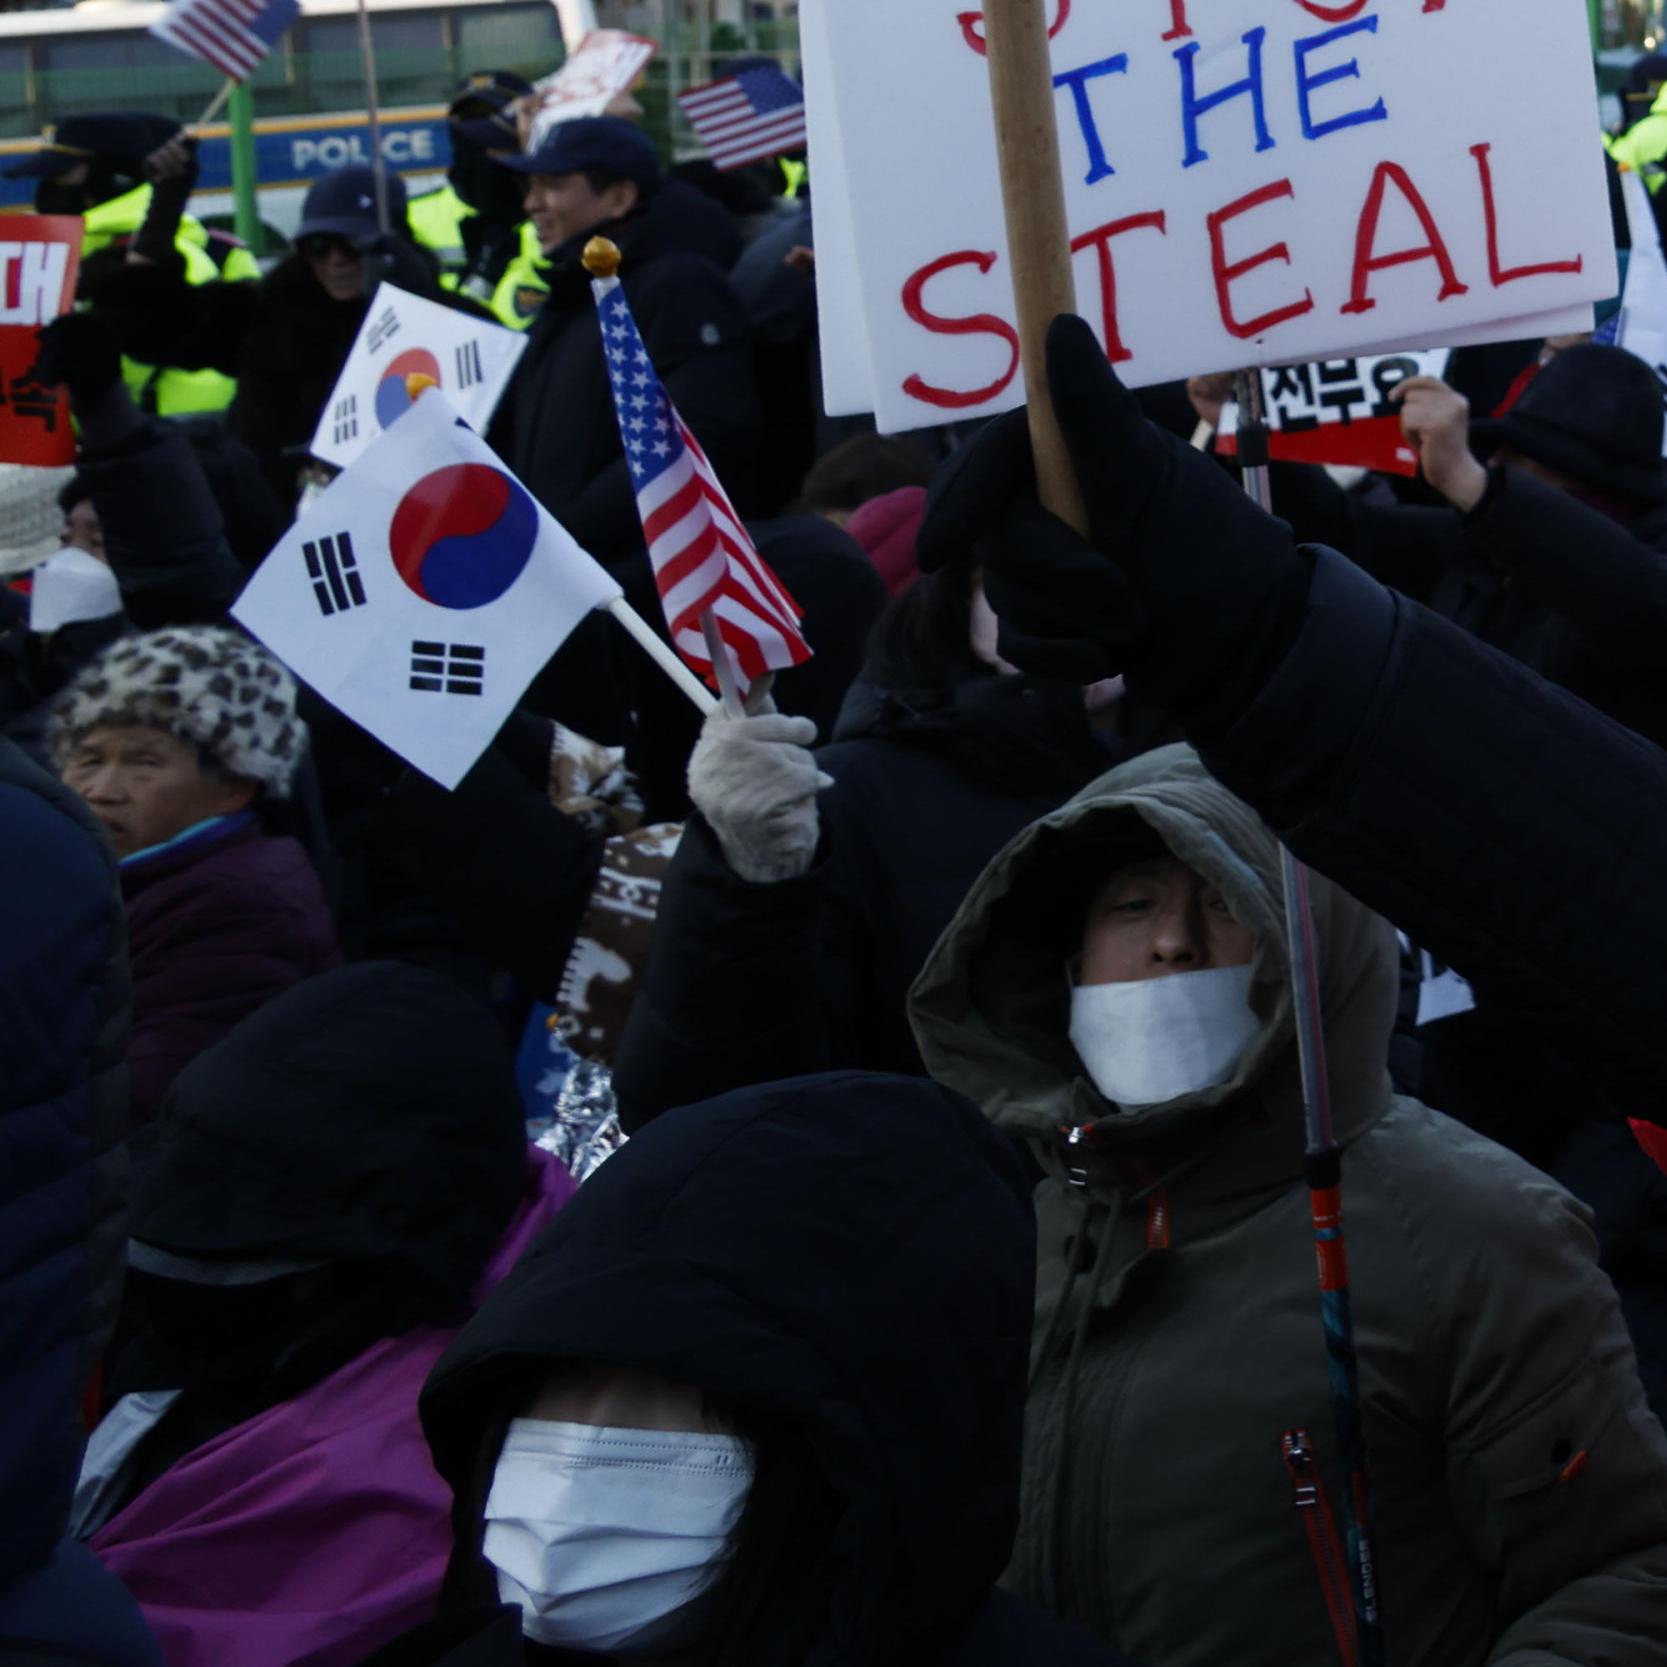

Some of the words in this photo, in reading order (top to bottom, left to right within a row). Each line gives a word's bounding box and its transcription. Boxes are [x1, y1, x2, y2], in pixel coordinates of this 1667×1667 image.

[292, 129, 433, 172] POLCE
[1053, 15, 1388, 185] THE
[901, 142, 1583, 409] STEAL
